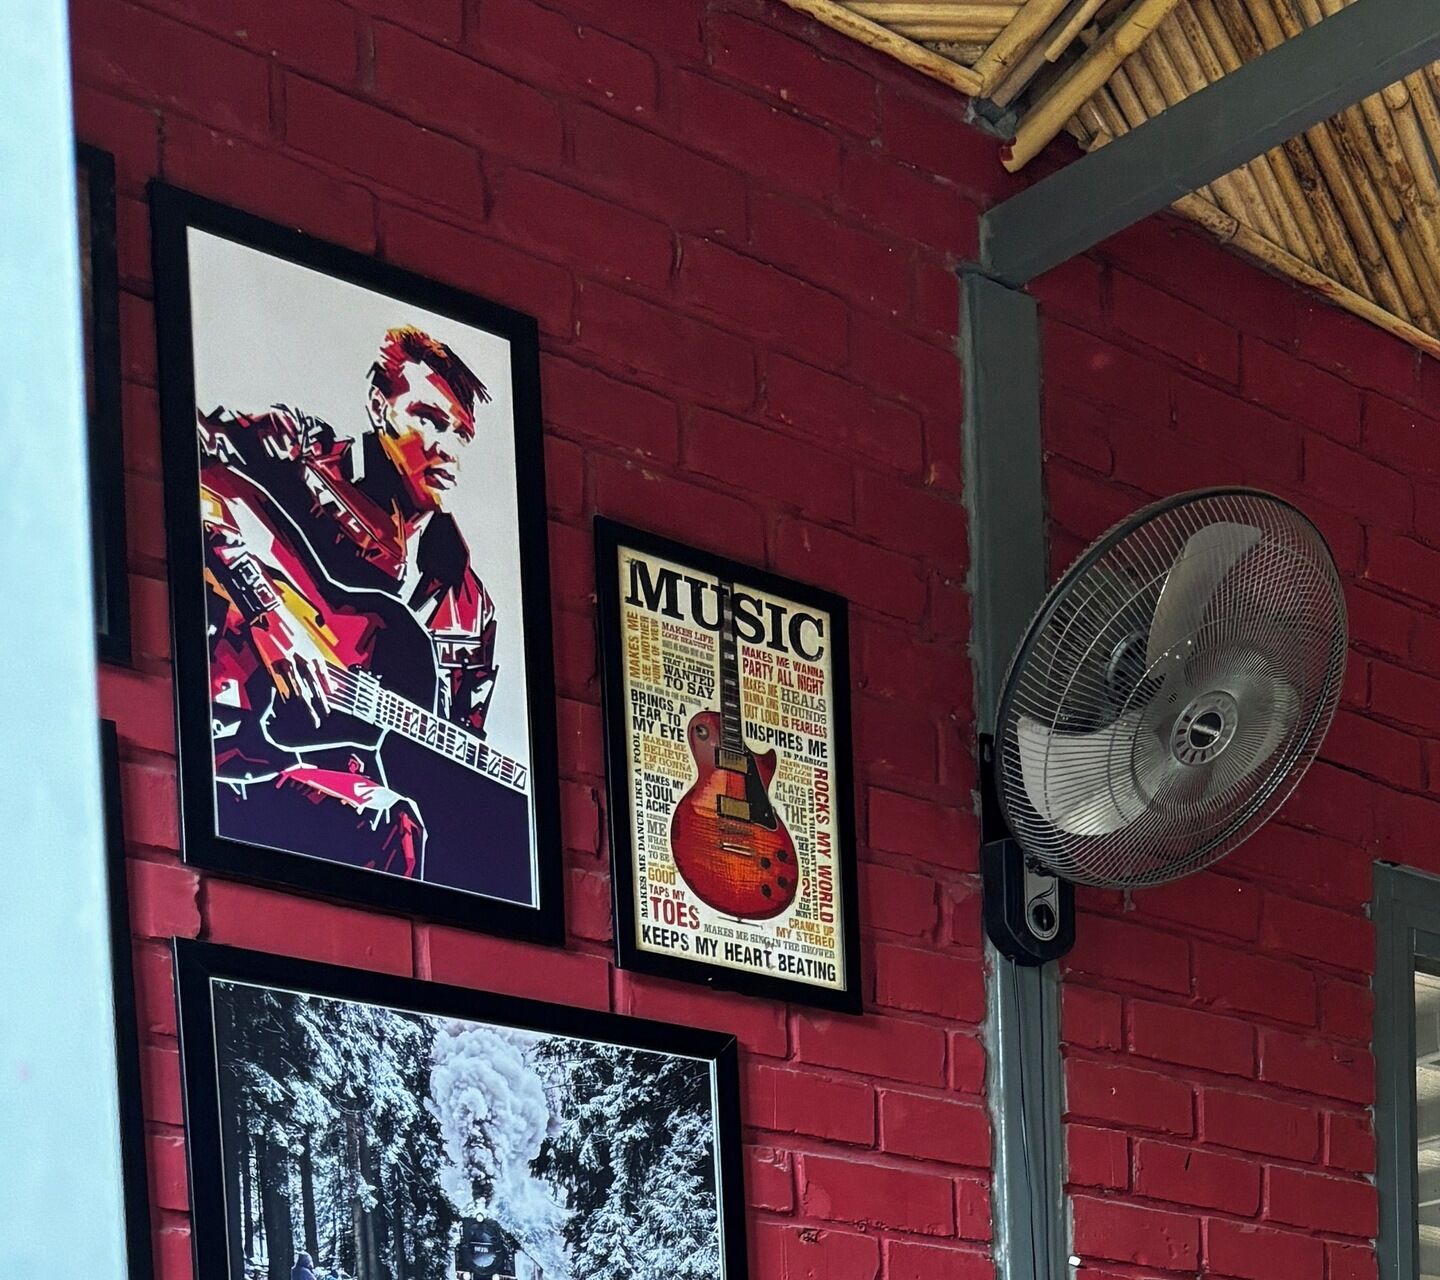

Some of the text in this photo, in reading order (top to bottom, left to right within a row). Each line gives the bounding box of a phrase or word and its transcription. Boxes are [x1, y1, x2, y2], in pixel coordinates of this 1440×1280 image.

[625, 558, 824, 662] MUSIC
[627, 611, 640, 678] MAKES ME
[662, 622, 714, 645] MAKES LIFE
[640, 616, 651, 682] SEE ANOTHER
[652, 645, 660, 656] OF
[652, 659, 660, 685] POINT
[663, 656, 681, 667] THAT
[742, 645, 824, 680] MAKES ME WANNA
[663, 664, 714, 688] WANTED
[664, 675, 683, 691] TO
[687, 682, 714, 700] SAY
[742, 658, 773, 682] PARTY
[778, 668, 794, 688] ALL
[797, 673, 824, 697] NIGHT
[743, 676, 778, 698] MAKES ME
[631, 688, 674, 713] BRINGS
[679, 702, 687, 717] A
[781, 687, 826, 713] HEALS
[632, 702, 681, 727] TEAR TO
[744, 703, 779, 726] OUT LOUD
[781, 703, 826, 725] WOUNDS
[632, 716, 685, 743] MY EYE
[782, 716, 827, 739] IS FEARLESS
[643, 734, 687, 752] MAKES ME
[745, 721, 828, 758] INSPIRES ME
[643, 743, 689, 763] BELIEVE
[644, 753, 692, 773] I'M GONNA
[643, 772, 685, 791] MAKES MY
[644, 763, 693, 781] BE ALRIGHT
[645, 783, 677, 804] SOUL
[775, 792, 806, 806] ALL OVER
[776, 781, 806, 797] PLAYS
[646, 799, 671, 815] ACHE
[782, 803, 807, 826] THE
[633, 733, 648, 918] MAKES ME DANCE LIKE A FOOL
[646, 820, 667, 837] ME
[647, 835, 667, 846] WHAT
[814, 767, 833, 923] ROCKS MY WORLD
[648, 850, 658, 860] TO
[648, 867, 676, 885] GOOD
[648, 883, 685, 902] TAPS MY
[802, 878, 811, 898] 2
[649, 895, 700, 930] TOES
[776, 926, 835, 949] MY STEREO
[789, 918, 834, 936] CRANKS UP
[704, 923, 835, 959] MAKES ME SING IN THE SHOWER
[642, 924, 836, 982] KEEPS MY HEART BEATING
